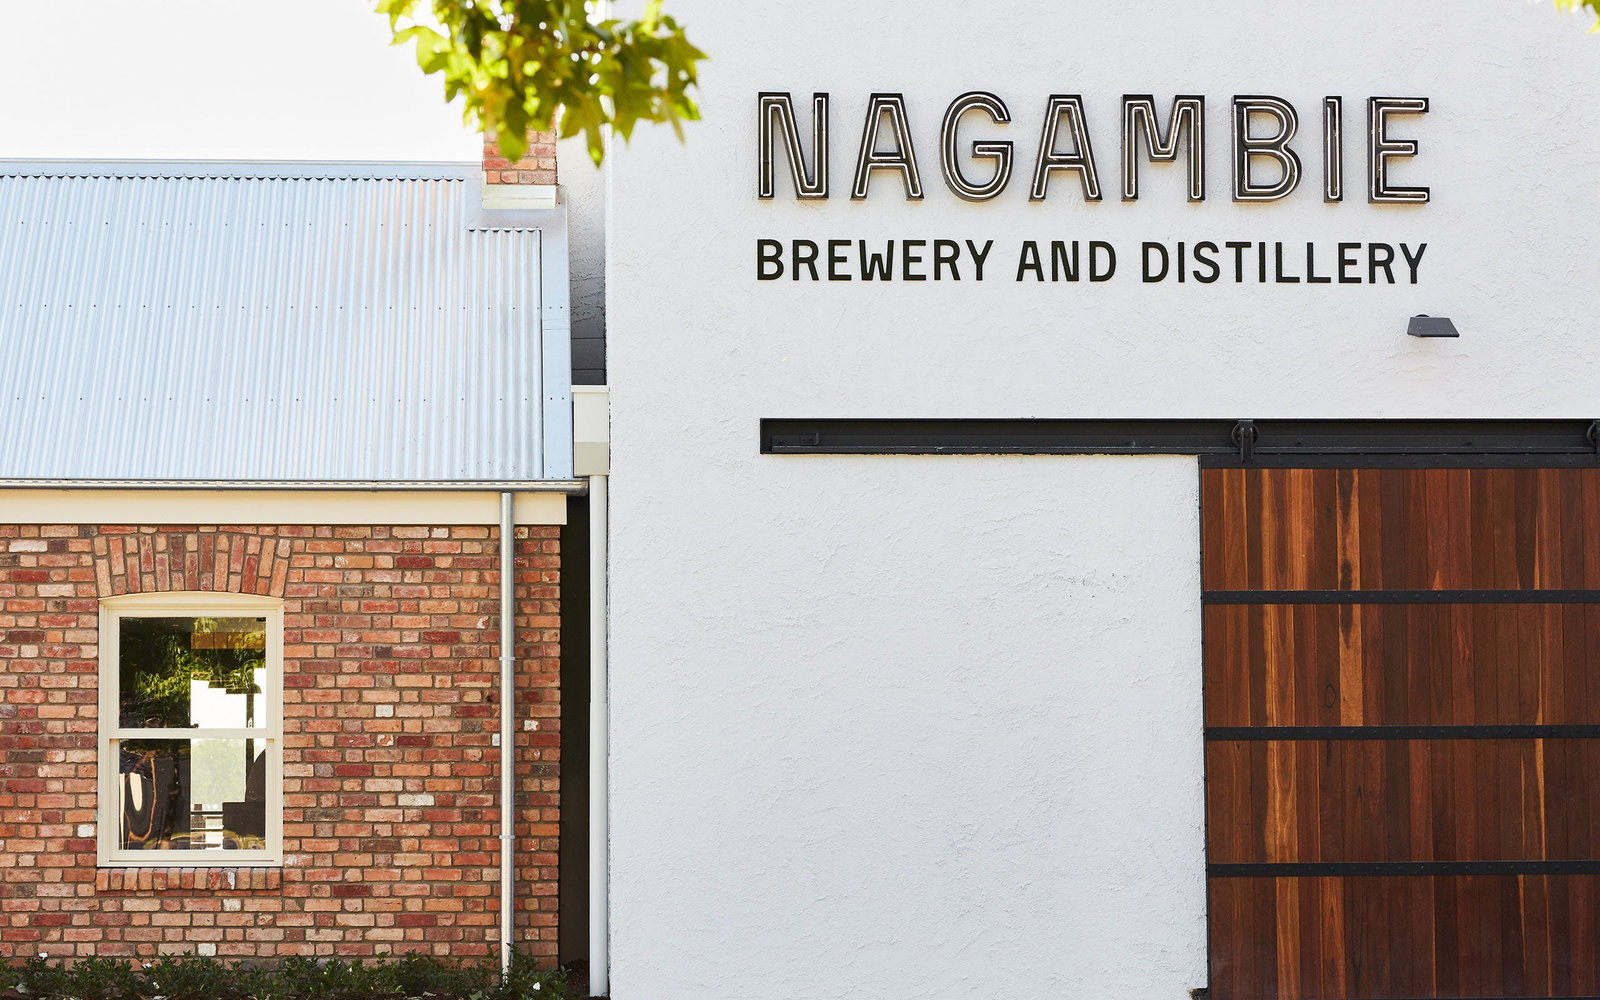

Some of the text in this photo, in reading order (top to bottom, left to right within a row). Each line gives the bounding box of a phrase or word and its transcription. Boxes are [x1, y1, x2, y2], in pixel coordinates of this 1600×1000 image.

[758, 91, 1430, 204] NAGAMBIE
[757, 239, 1428, 284] BREWERY AND DISTILLERY
